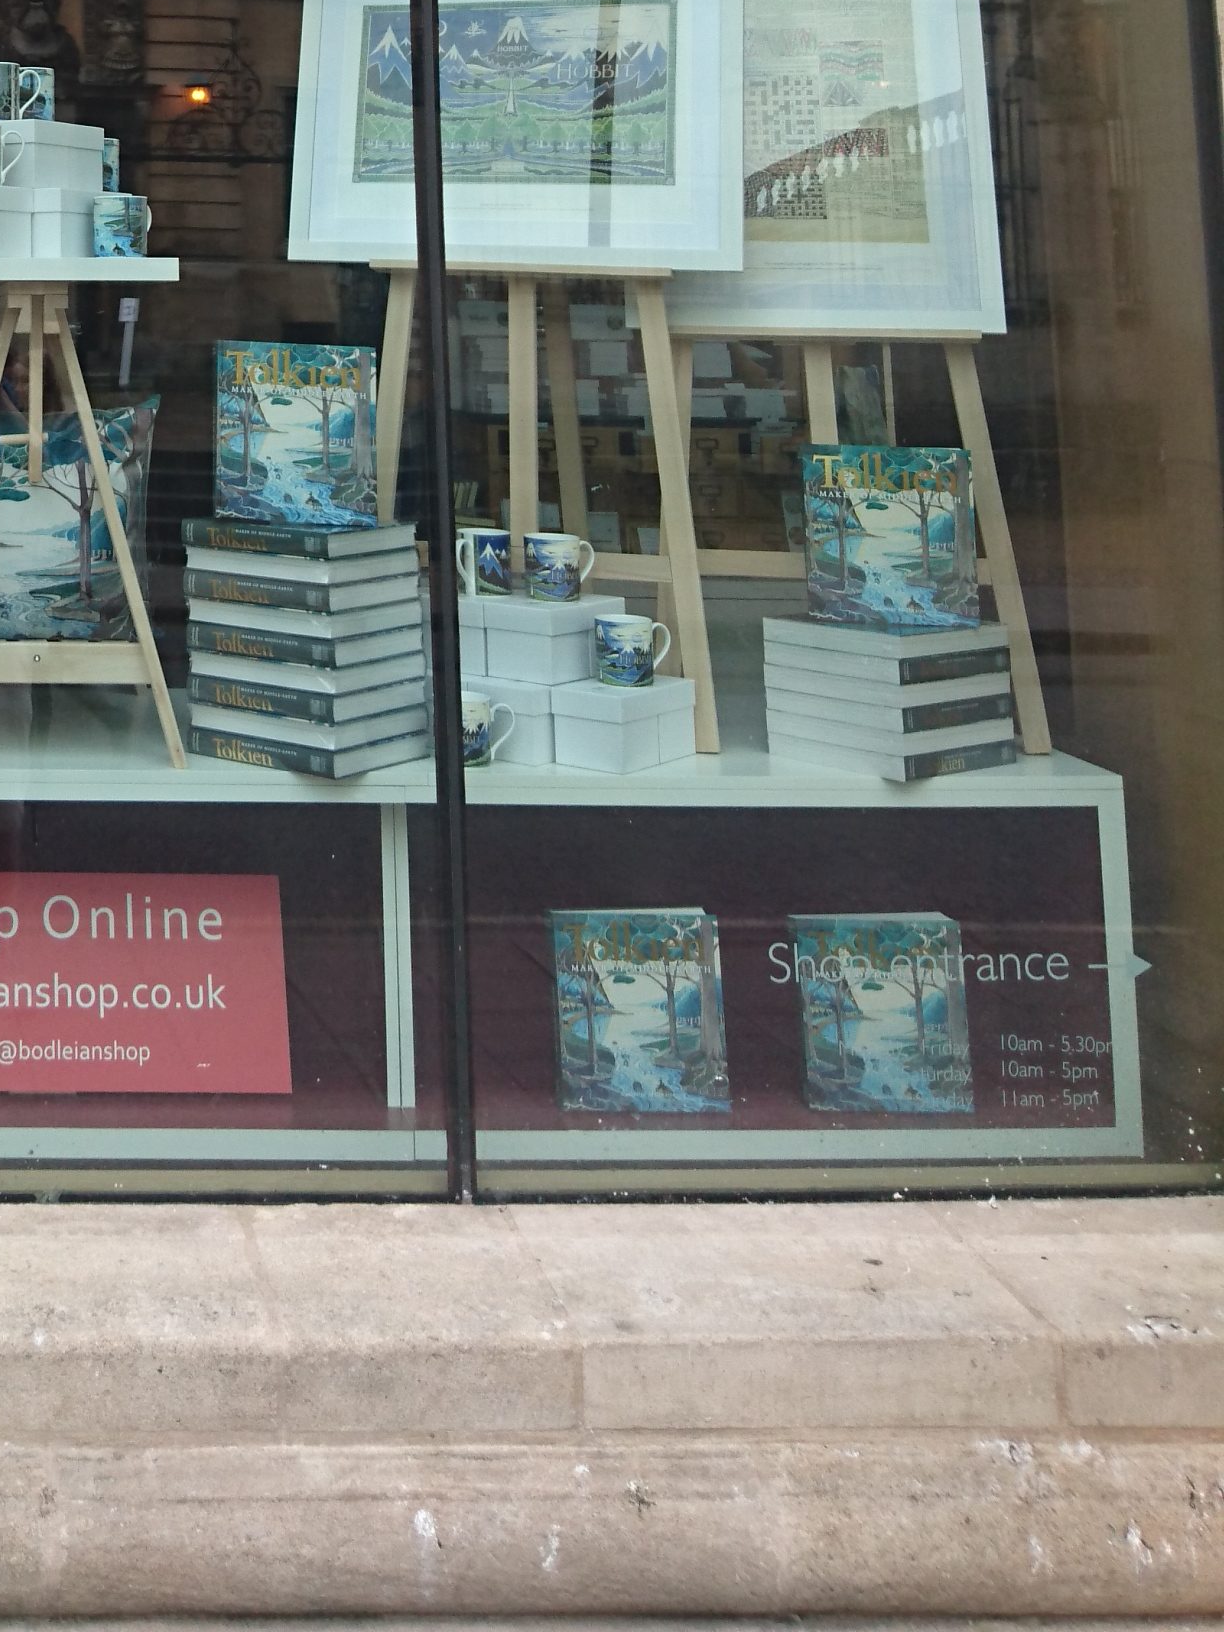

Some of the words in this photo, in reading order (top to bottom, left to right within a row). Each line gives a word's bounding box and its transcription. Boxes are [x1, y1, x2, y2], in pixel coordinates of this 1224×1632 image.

[556, 63, 635, 80] HOBBIT
[225, 348, 362, 391] Tolkien
[812, 451, 958, 494] Tolkien
[206, 527, 269, 551] Tolkien
[208, 578, 270, 604] Tolkien
[212, 631, 274, 658] Tolkien
[213, 683, 274, 712] Tolkien
[212, 737, 274, 767] Tolkien
[42, 892, 224, 941] Online
[563, 920, 707, 962] Tolkien
[890, 948, 1071, 983] entrance
[1000, 1034, 1044, 1053] 10am
[1001, 1060, 1044, 1078] 10am
[1062, 1061, 1099, 1083] 5pm
[1002, 1089, 1045, 1108] 11am
[1063, 1089, 1099, 1111] 5pm
